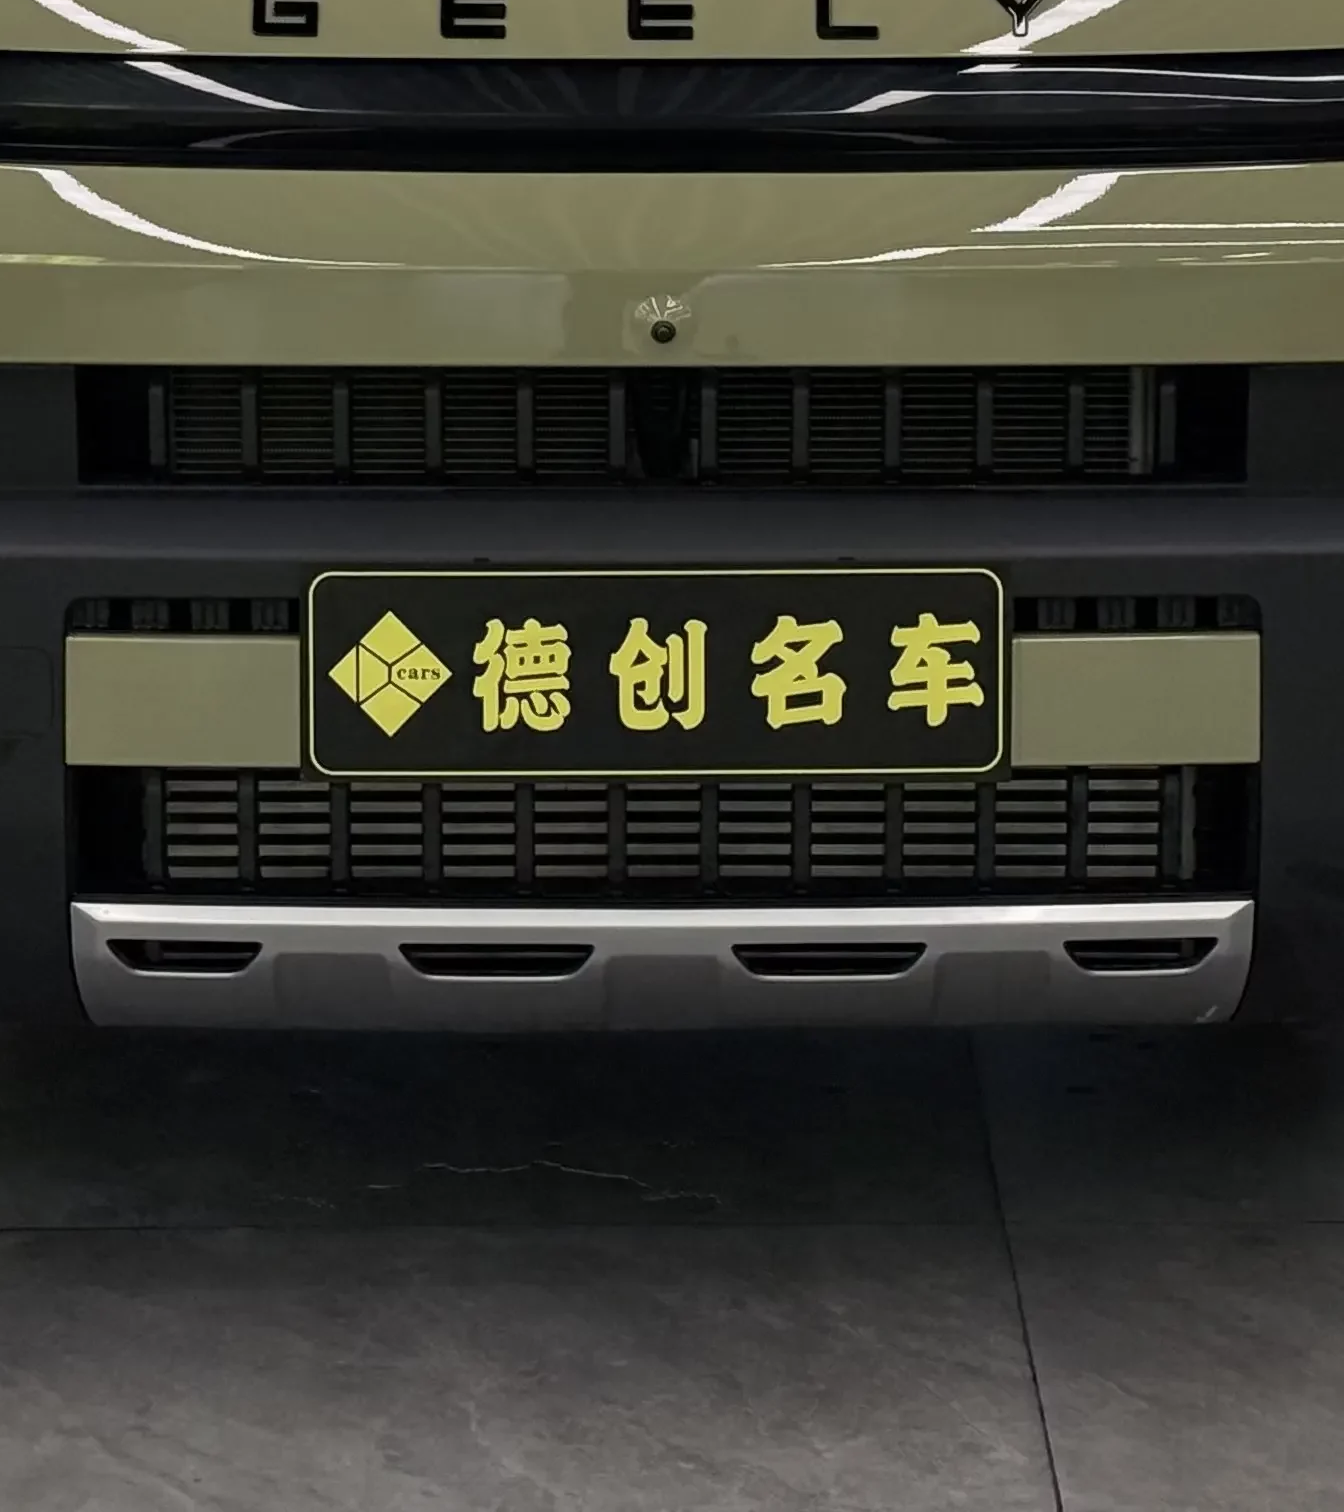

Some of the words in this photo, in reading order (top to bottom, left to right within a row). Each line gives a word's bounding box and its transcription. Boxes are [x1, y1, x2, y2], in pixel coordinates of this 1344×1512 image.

[396, 667, 442, 681] cars
[471, 612, 986, 733] 德创名车
